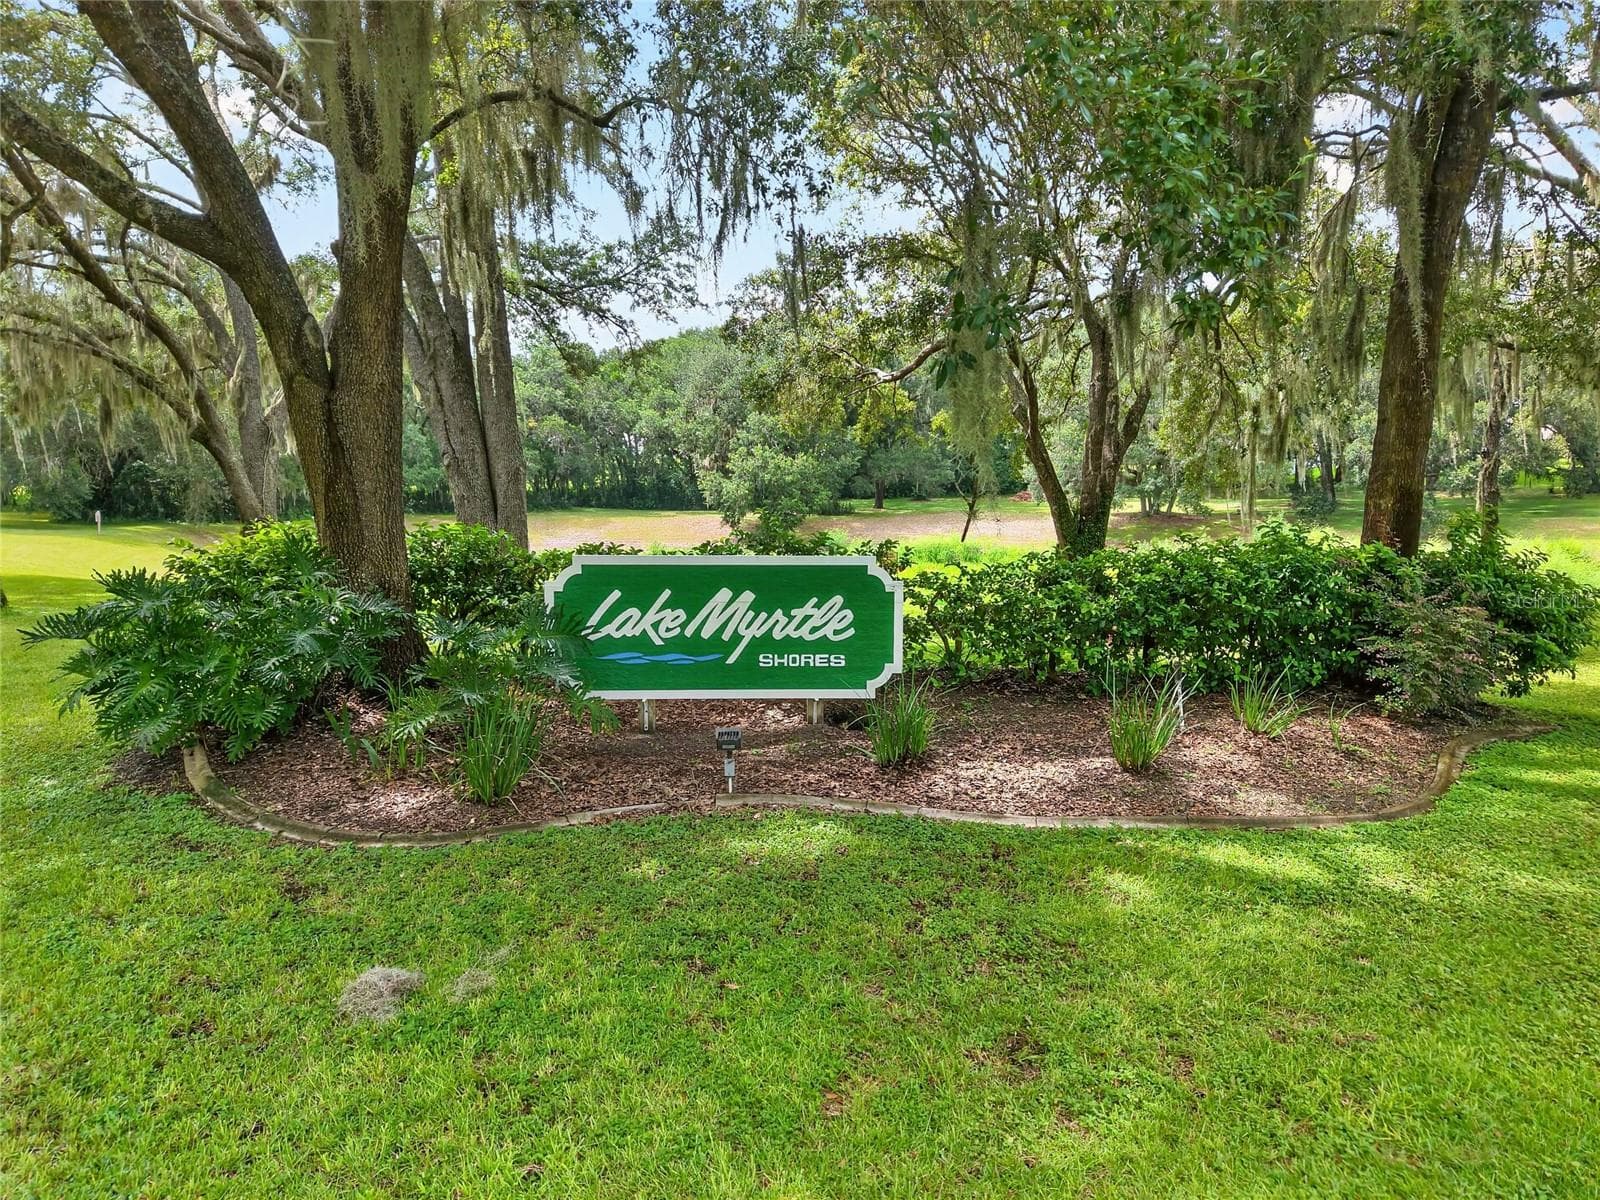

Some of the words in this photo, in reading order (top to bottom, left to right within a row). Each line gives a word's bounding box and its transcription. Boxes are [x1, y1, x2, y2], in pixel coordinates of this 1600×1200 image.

[580, 588, 687, 645] Lake
[684, 587, 855, 664] Myrtle
[758, 653, 846, 668] SHORES
